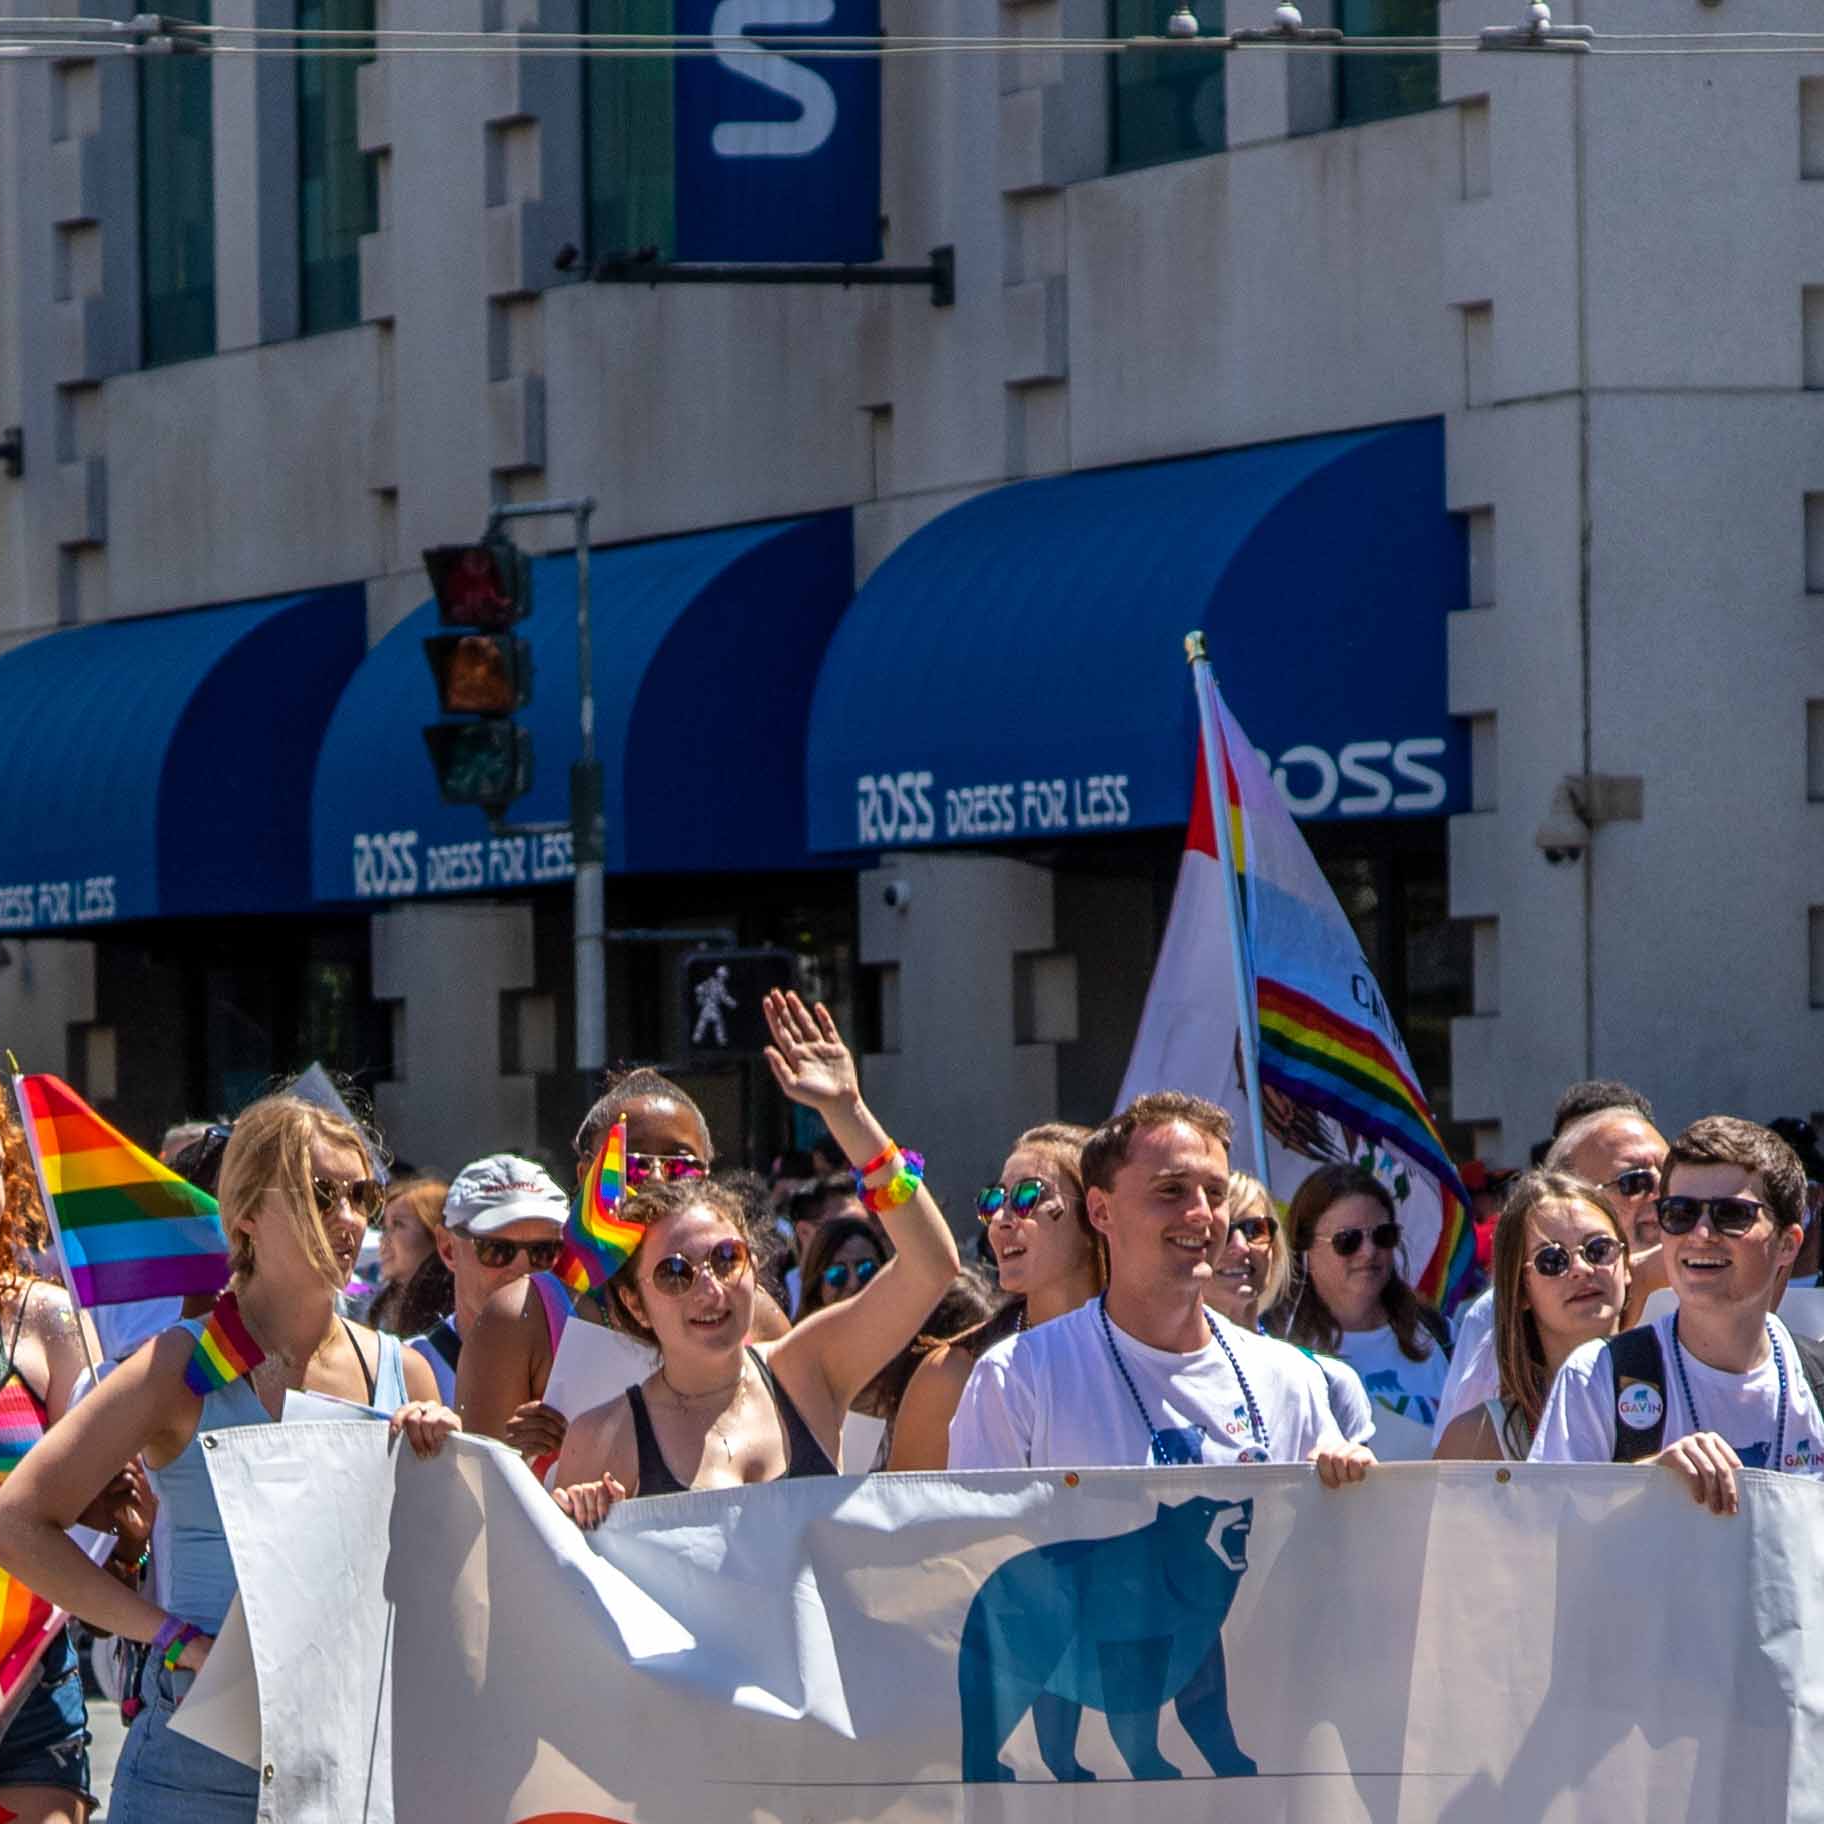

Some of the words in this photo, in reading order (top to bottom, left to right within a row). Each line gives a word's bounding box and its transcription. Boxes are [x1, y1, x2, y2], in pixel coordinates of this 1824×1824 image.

[1256, 738, 1447, 815] OSS
[858, 770, 936, 843] ROSS
[945, 783, 1017, 836] DRESS
[1021, 778, 1069, 829] FOR
[1074, 773, 1131, 827] LESS
[352, 830, 419, 897] ROSS
[426, 841, 484, 890] DRESS
[488, 836, 526, 883] FOR
[532, 831, 576, 880] LESS
[37, 881, 71, 926] FOR
[75, 875, 117, 919] LESS
[1620, 1401, 1662, 1414] GAVIN
[1783, 1452, 1824, 1467] GAVIN
